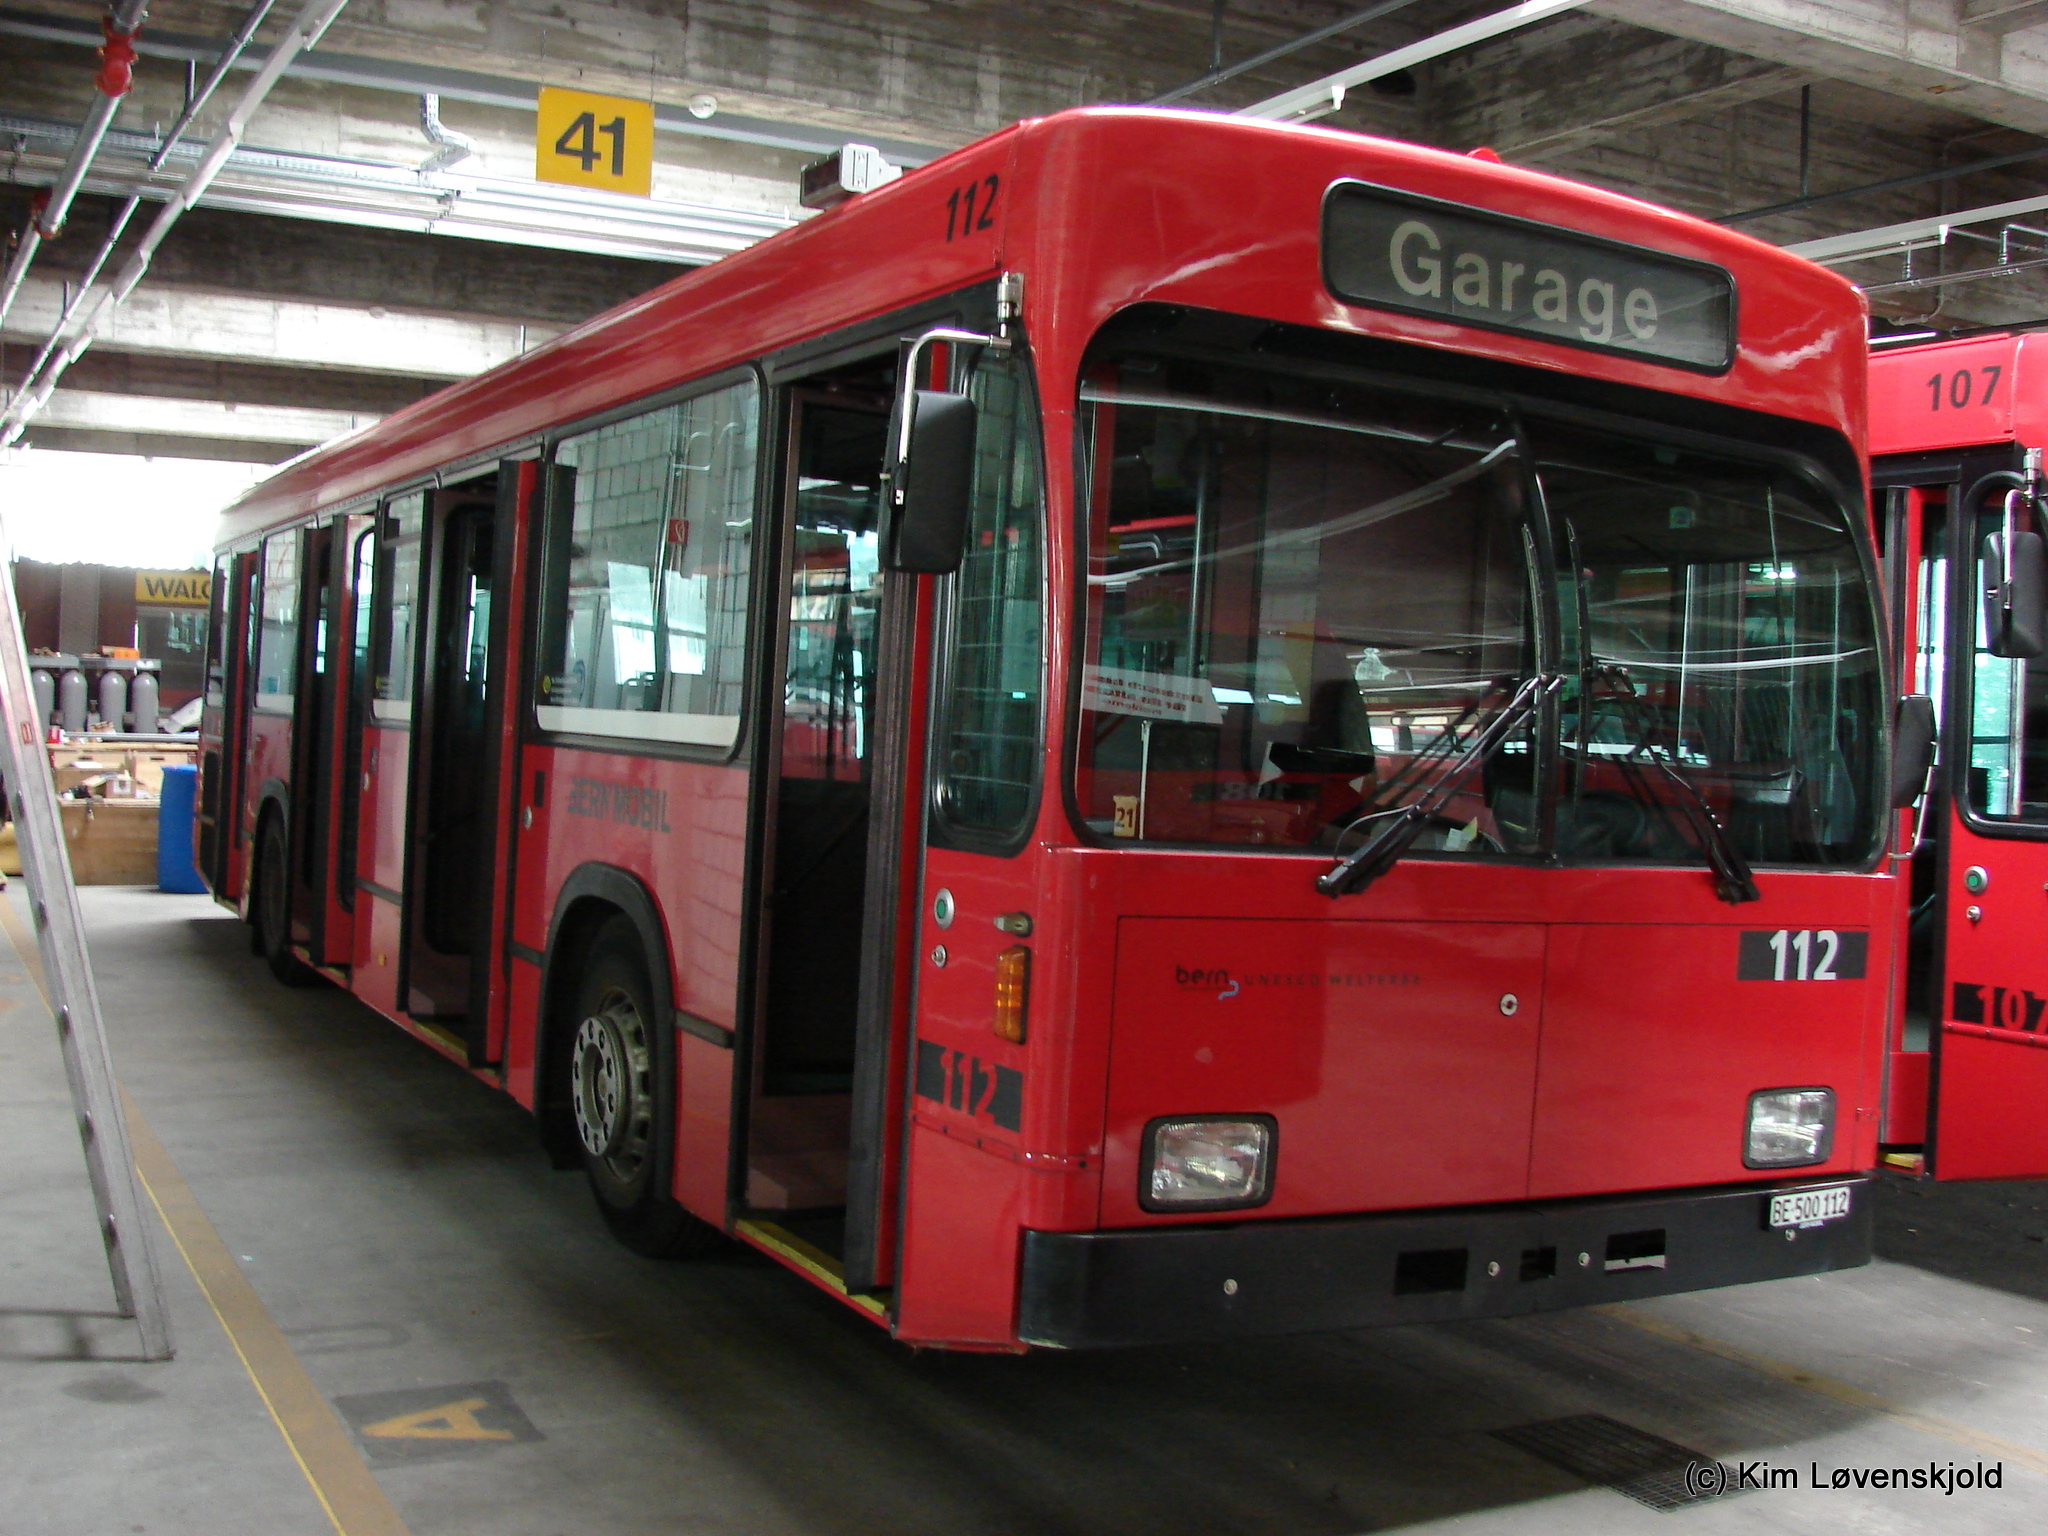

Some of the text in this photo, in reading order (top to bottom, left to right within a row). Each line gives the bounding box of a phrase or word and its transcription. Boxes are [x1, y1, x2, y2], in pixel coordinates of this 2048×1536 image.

[555, 111, 625, 176] 41
[946, 173, 999, 242] 112
[1390, 220, 1658, 344] Garage
[1926, 365, 2002, 411] 107
[1116, 806, 1134, 829] 21
[1175, 964, 1230, 985] bern
[1243, 973, 1319, 986] UNESCO
[1769, 929, 1839, 981] 112
[1976, 985, 2048, 1034] 107
[940, 1046, 998, 1125] 112
[361, 1398, 516, 1441] A
